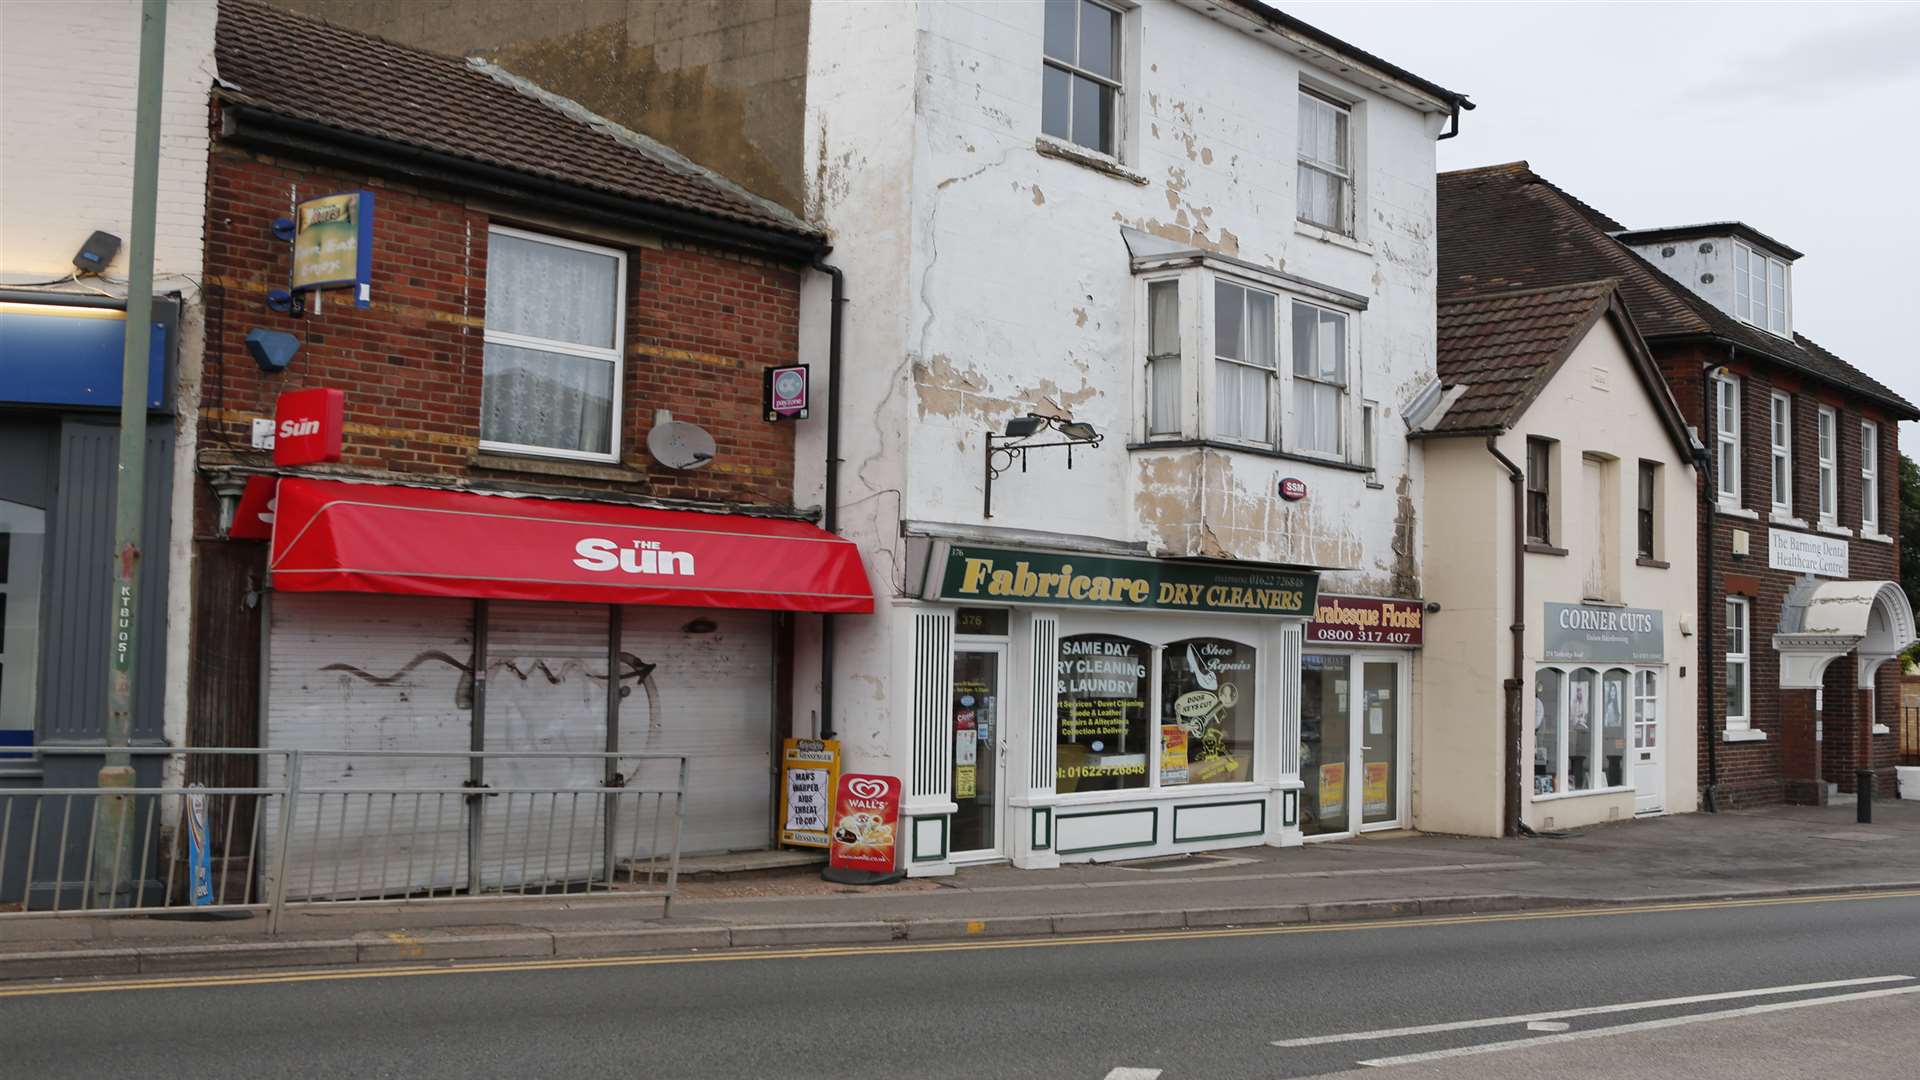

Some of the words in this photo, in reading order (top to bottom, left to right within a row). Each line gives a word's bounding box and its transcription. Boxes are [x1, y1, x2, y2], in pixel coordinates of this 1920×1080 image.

[279, 419, 320, 438] Sun
[1286, 481, 1305, 493] SSM
[632, 540, 661, 549] THE
[1773, 534, 1788, 549] The
[1823, 542, 1846, 558] Dental
[572, 537, 695, 575] Sun
[1777, 552, 1818, 570] Healthcare
[1820, 558, 1843, 573] Centre
[959, 557, 1150, 603] Fabricare
[1156, 582, 1204, 605] DRY
[1206, 585, 1303, 611] CLEANERS
[962, 615, 983, 626] 376
[1382, 603, 1421, 629] Florist
[1560, 608, 1617, 631] CORNER
[1620, 613, 1652, 633] CUTS
[1318, 629, 1354, 641] 0800
[1358, 631, 1382, 642] 317
[1386, 632, 1411, 643] 407
[1062, 641, 1102, 655] SAME
[1103, 642, 1131, 656] DAY
[1201, 643, 1233, 656] Shoe
[1057, 660, 1074, 674] RY
[1076, 660, 1146, 678] CLEANING
[1206, 658, 1251, 674] Repairs
[1057, 680, 1067, 694] &
[1070, 679, 1135, 694] LAUNDRY
[1063, 700, 1093, 708] Services
[1097, 700, 1116, 708] Duvet
[1117, 700, 1145, 709] Cleaning
[1187, 694, 1206, 704] DOOR
[1071, 709, 1090, 717] Suede
[1182, 704, 1200, 714] KEYS
[1200, 701, 1213, 710] CUT
[1062, 719, 1087, 727] Repairs
[1094, 718, 1129, 726] Alterations
[1062, 727, 1096, 735] Collection
[1102, 727, 1128, 735] Delivery
[1067, 764, 1145, 778] 01622-726848
[792, 783, 819, 792] WARPED
[798, 794, 813, 803] AIDS
[848, 799, 885, 810] WALL'S
[795, 806, 817, 814] THREAT
[795, 817, 803, 825] TO
[804, 817, 817, 825] COP
